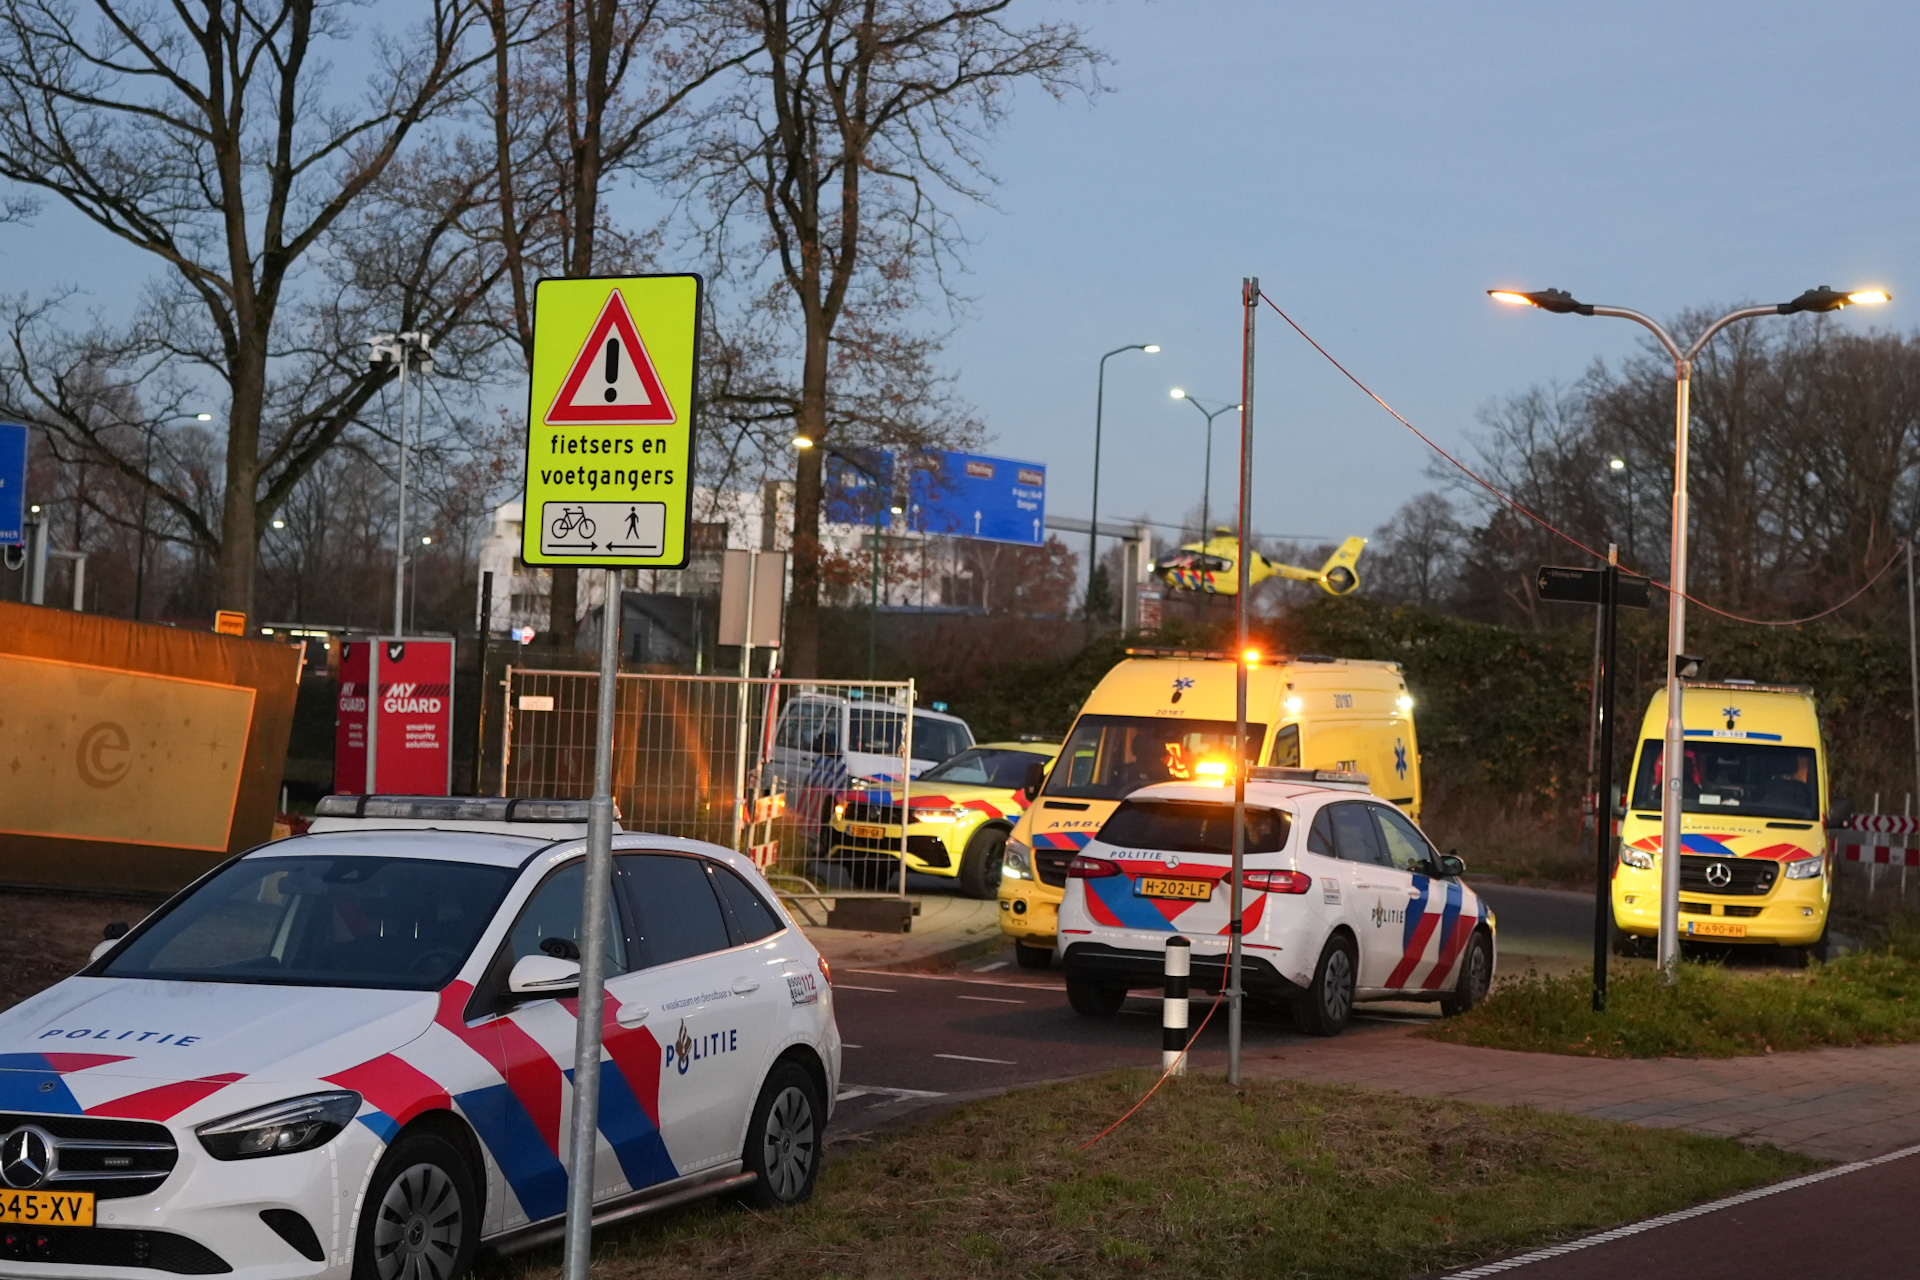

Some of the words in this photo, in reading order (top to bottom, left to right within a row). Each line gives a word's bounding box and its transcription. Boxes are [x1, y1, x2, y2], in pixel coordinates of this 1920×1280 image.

[551, 435, 633, 454] fietsers
[642, 439, 666, 454] en
[541, 466, 674, 491] voetgangers
[341, 682, 355, 696] MY
[386, 683, 416, 698] MY
[340, 697, 366, 713] GUARD
[384, 698, 441, 713] GUARD
[406, 724, 436, 732] smarter
[405, 733, 436, 741] security
[405, 741, 439, 750] solutions
[1683, 825, 1763, 834] AMBULANCE
[1110, 851, 1162, 860] POLITIE
[1145, 880, 1206, 896] H-202-LF
[1372, 908, 1404, 929] POLITIE
[1696, 924, 1743, 936] Z-690-RH
[801, 974, 816, 991] 112
[38, 1029, 202, 1047] POLITIE
[666, 1029, 737, 1075] POLITIE
